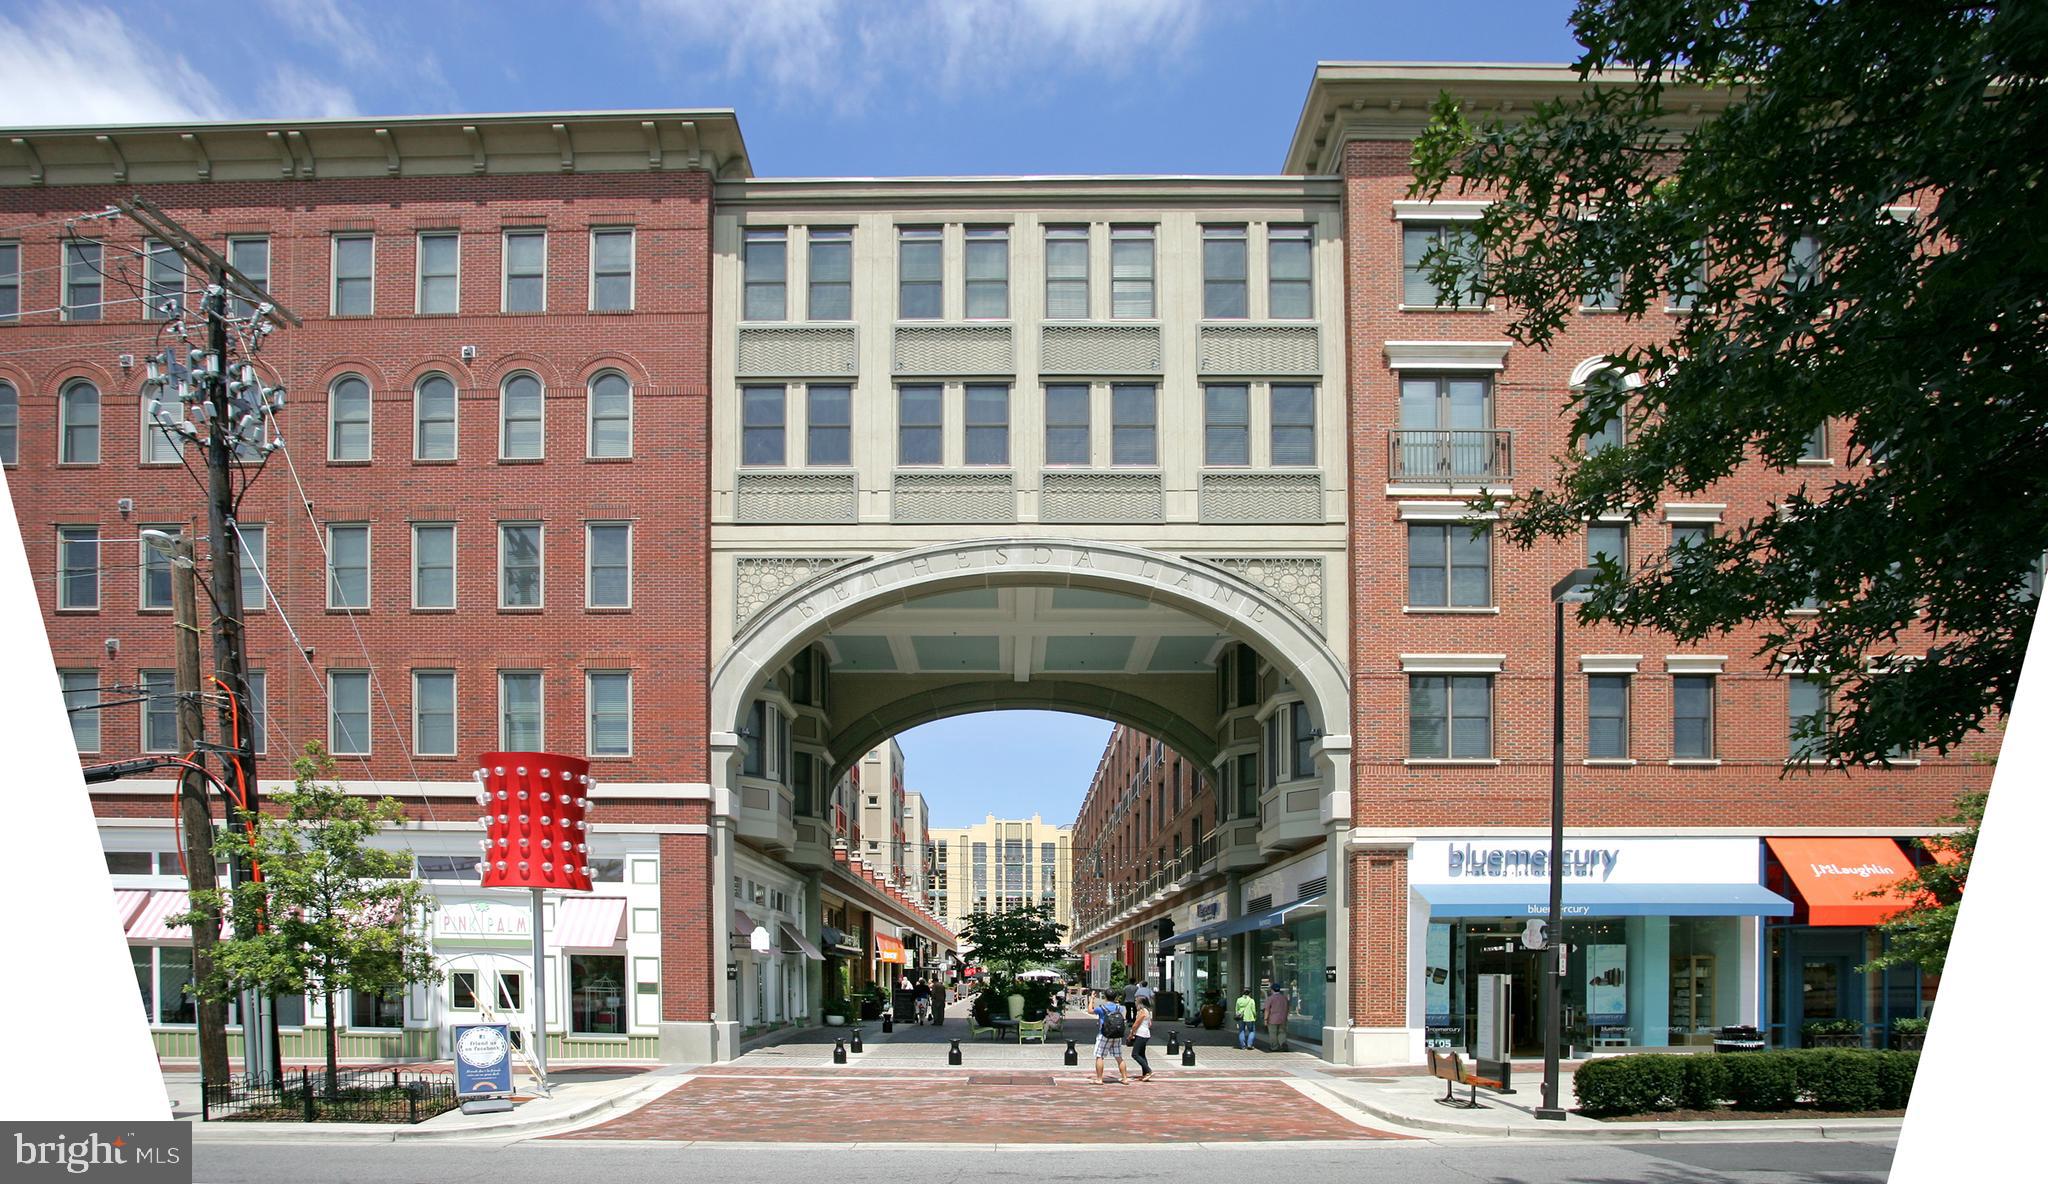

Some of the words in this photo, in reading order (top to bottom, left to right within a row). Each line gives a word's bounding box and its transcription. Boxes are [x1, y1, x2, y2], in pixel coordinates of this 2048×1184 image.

[796, 545, 1095, 618] BETHESDA
[1138, 560, 1265, 622] LANE
[1517, 868, 1567, 877] skince
[1527, 904, 1589, 915] bluercury
[443, 915, 477, 931] PINK
[487, 917, 526, 932] PALM
